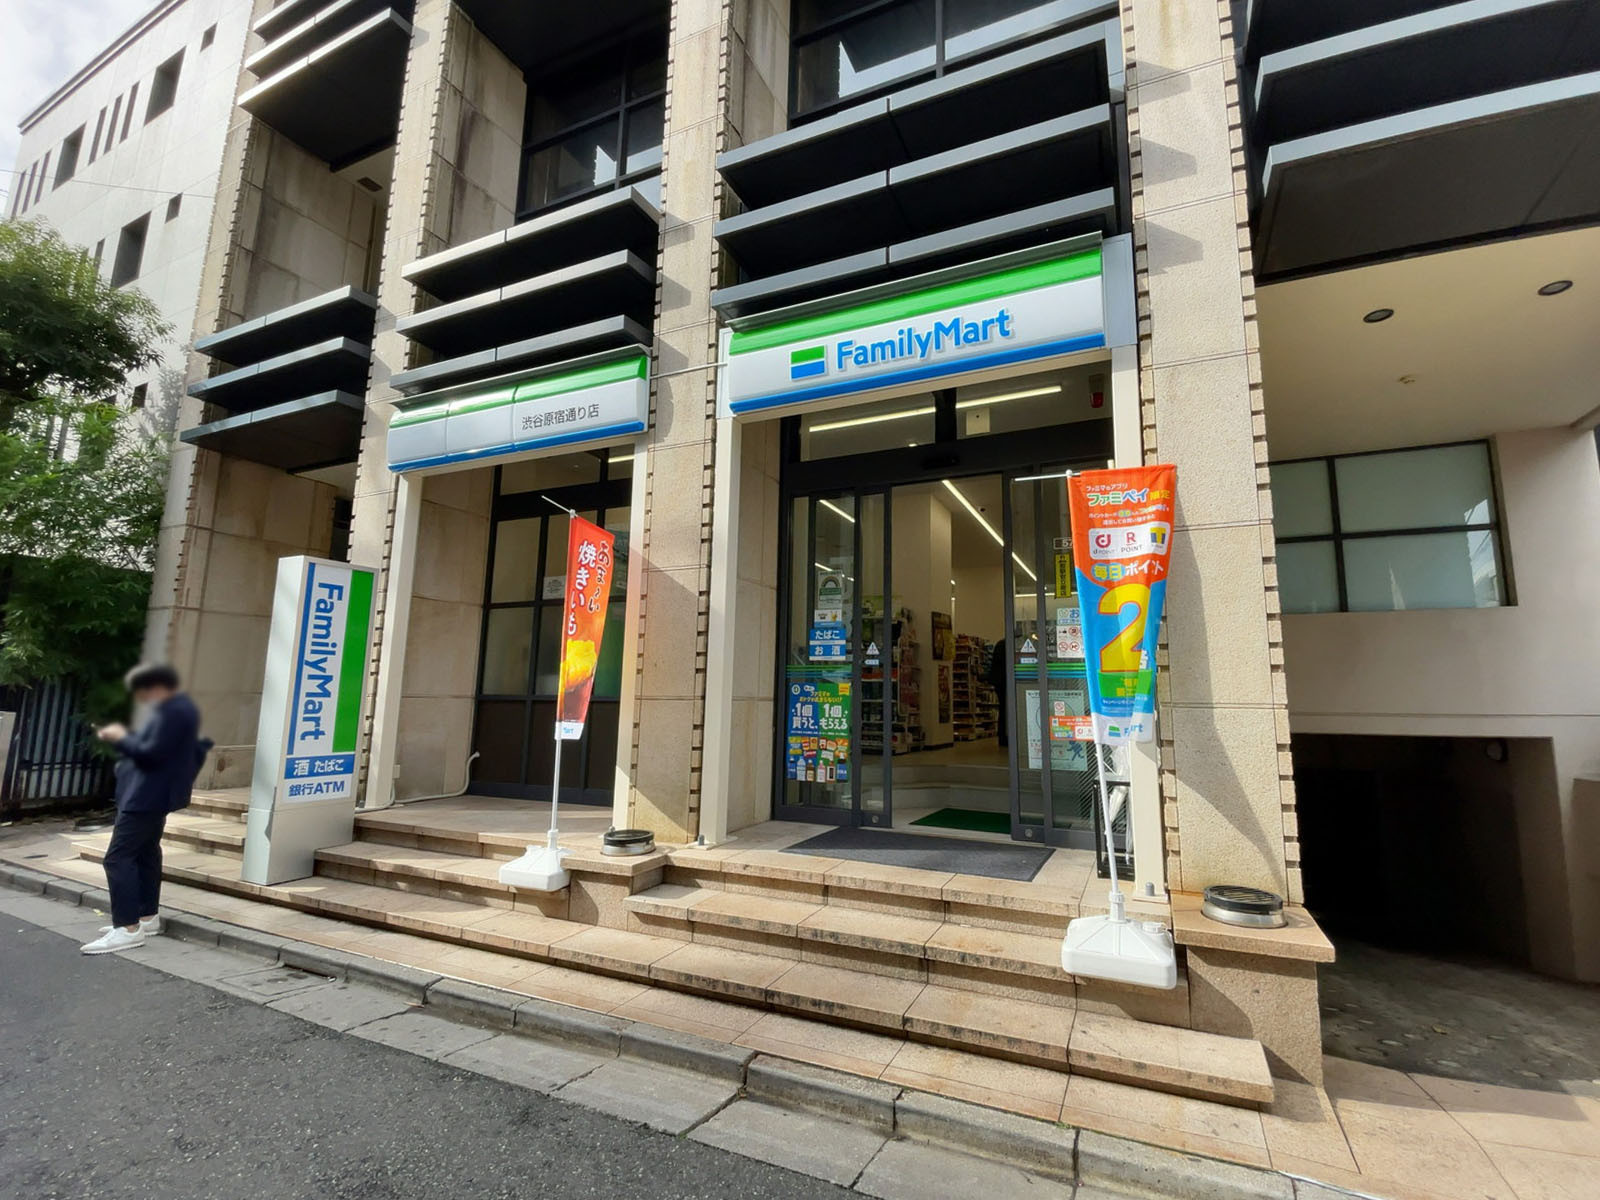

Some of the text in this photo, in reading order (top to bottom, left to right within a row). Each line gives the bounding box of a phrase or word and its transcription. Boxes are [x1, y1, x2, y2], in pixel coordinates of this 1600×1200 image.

[836, 308, 1010, 370] FamilyMart
[522, 403, 600, 430] 渋谷原宿通り店
[1126, 531, 1136, 544] R
[1121, 544, 1143, 553] POINT
[1094, 559, 1165, 580] 毎日ポイント
[567, 540, 597, 636] 焼きいも
[815, 630, 840, 640] たばこ
[300, 582, 344, 741] FamilyMart
[795, 702, 813, 717] 1個
[823, 703, 842, 718] 1個
[819, 717, 848, 730] もらえる
[293, 758, 345, 776] 酒 たばこ
[288, 780, 345, 797] 銀行ATM
